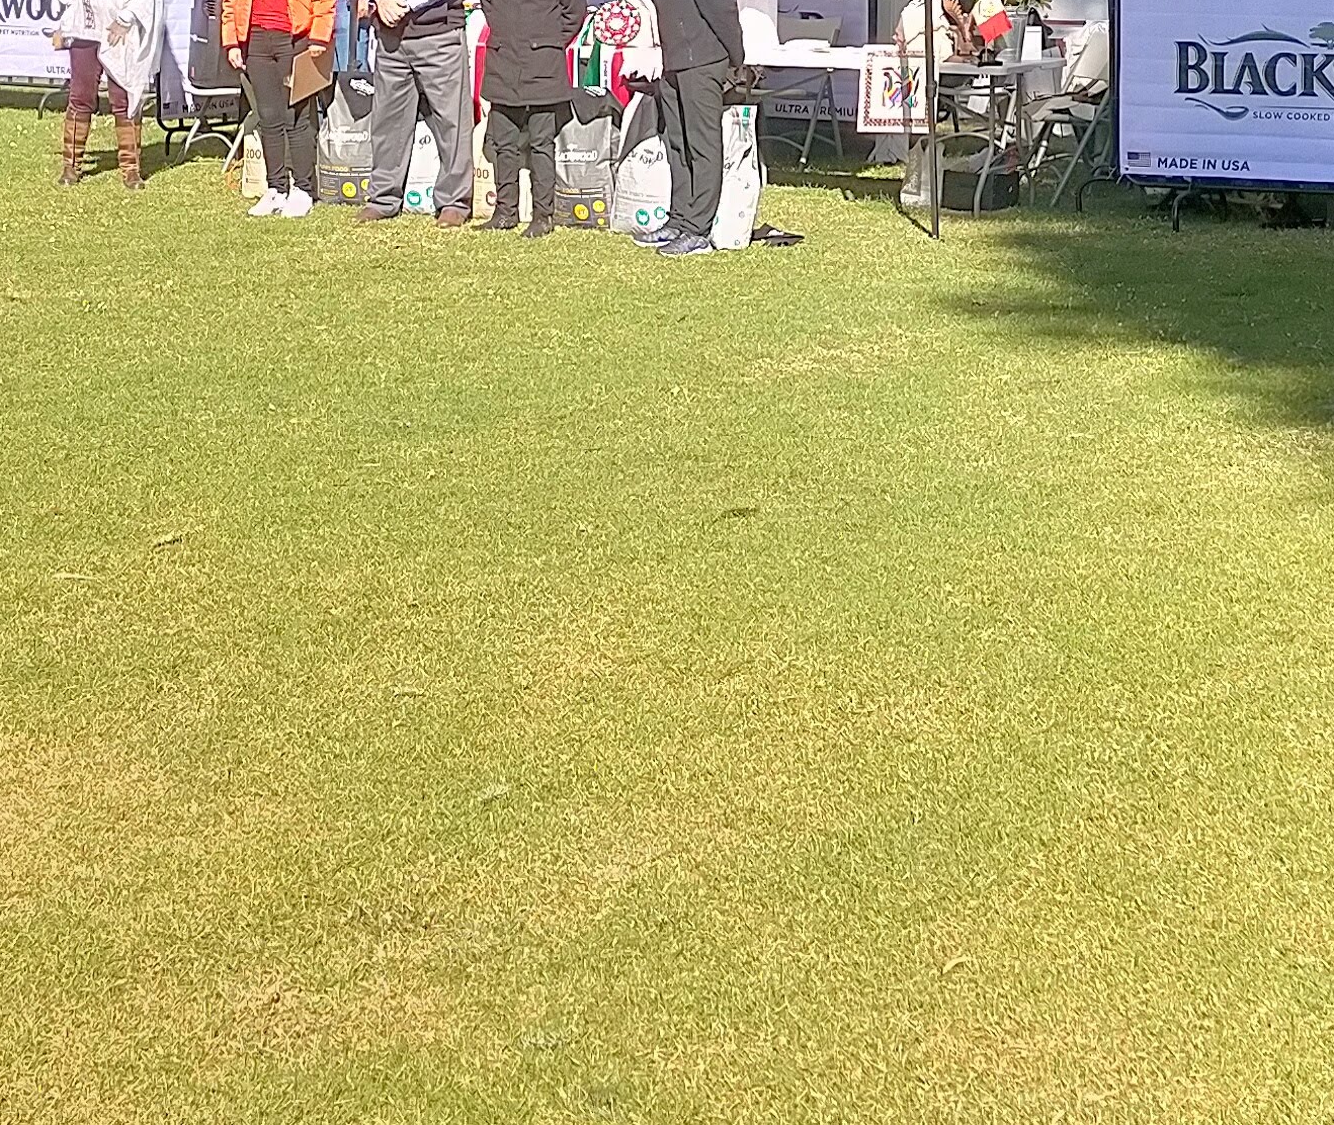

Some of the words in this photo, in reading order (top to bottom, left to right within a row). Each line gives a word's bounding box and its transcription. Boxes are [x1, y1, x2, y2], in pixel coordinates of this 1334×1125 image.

[775, 103, 809, 114] ULTRA
[1252, 110, 1283, 120] SLOW
[1286, 112, 1331, 122] COOKED
[1157, 157, 1198, 170] MADE
[1202, 159, 1217, 170] IN
[1221, 159, 1250, 172] USA
